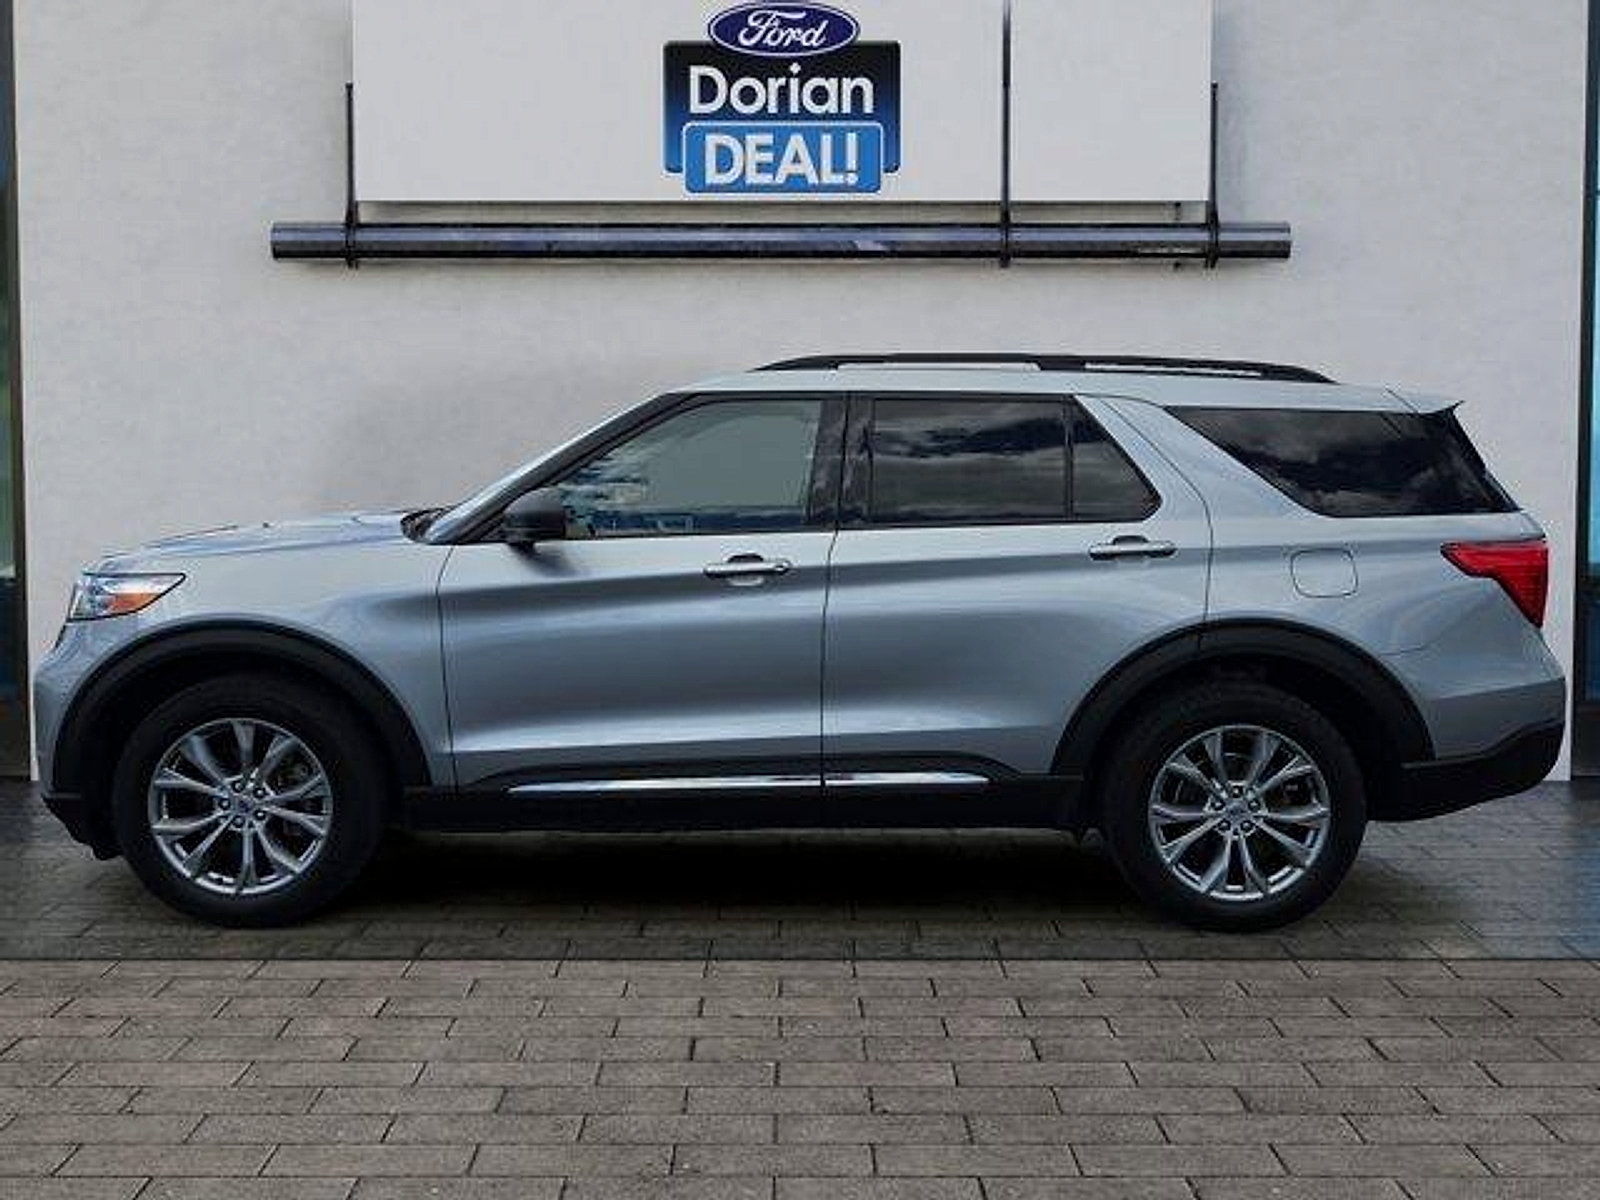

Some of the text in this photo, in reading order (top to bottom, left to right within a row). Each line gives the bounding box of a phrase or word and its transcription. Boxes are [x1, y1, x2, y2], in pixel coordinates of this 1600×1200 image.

[738, 10, 829, 47] Ford
[689, 62, 874, 114] Dorian
[704, 132, 859, 185] DEAL!
